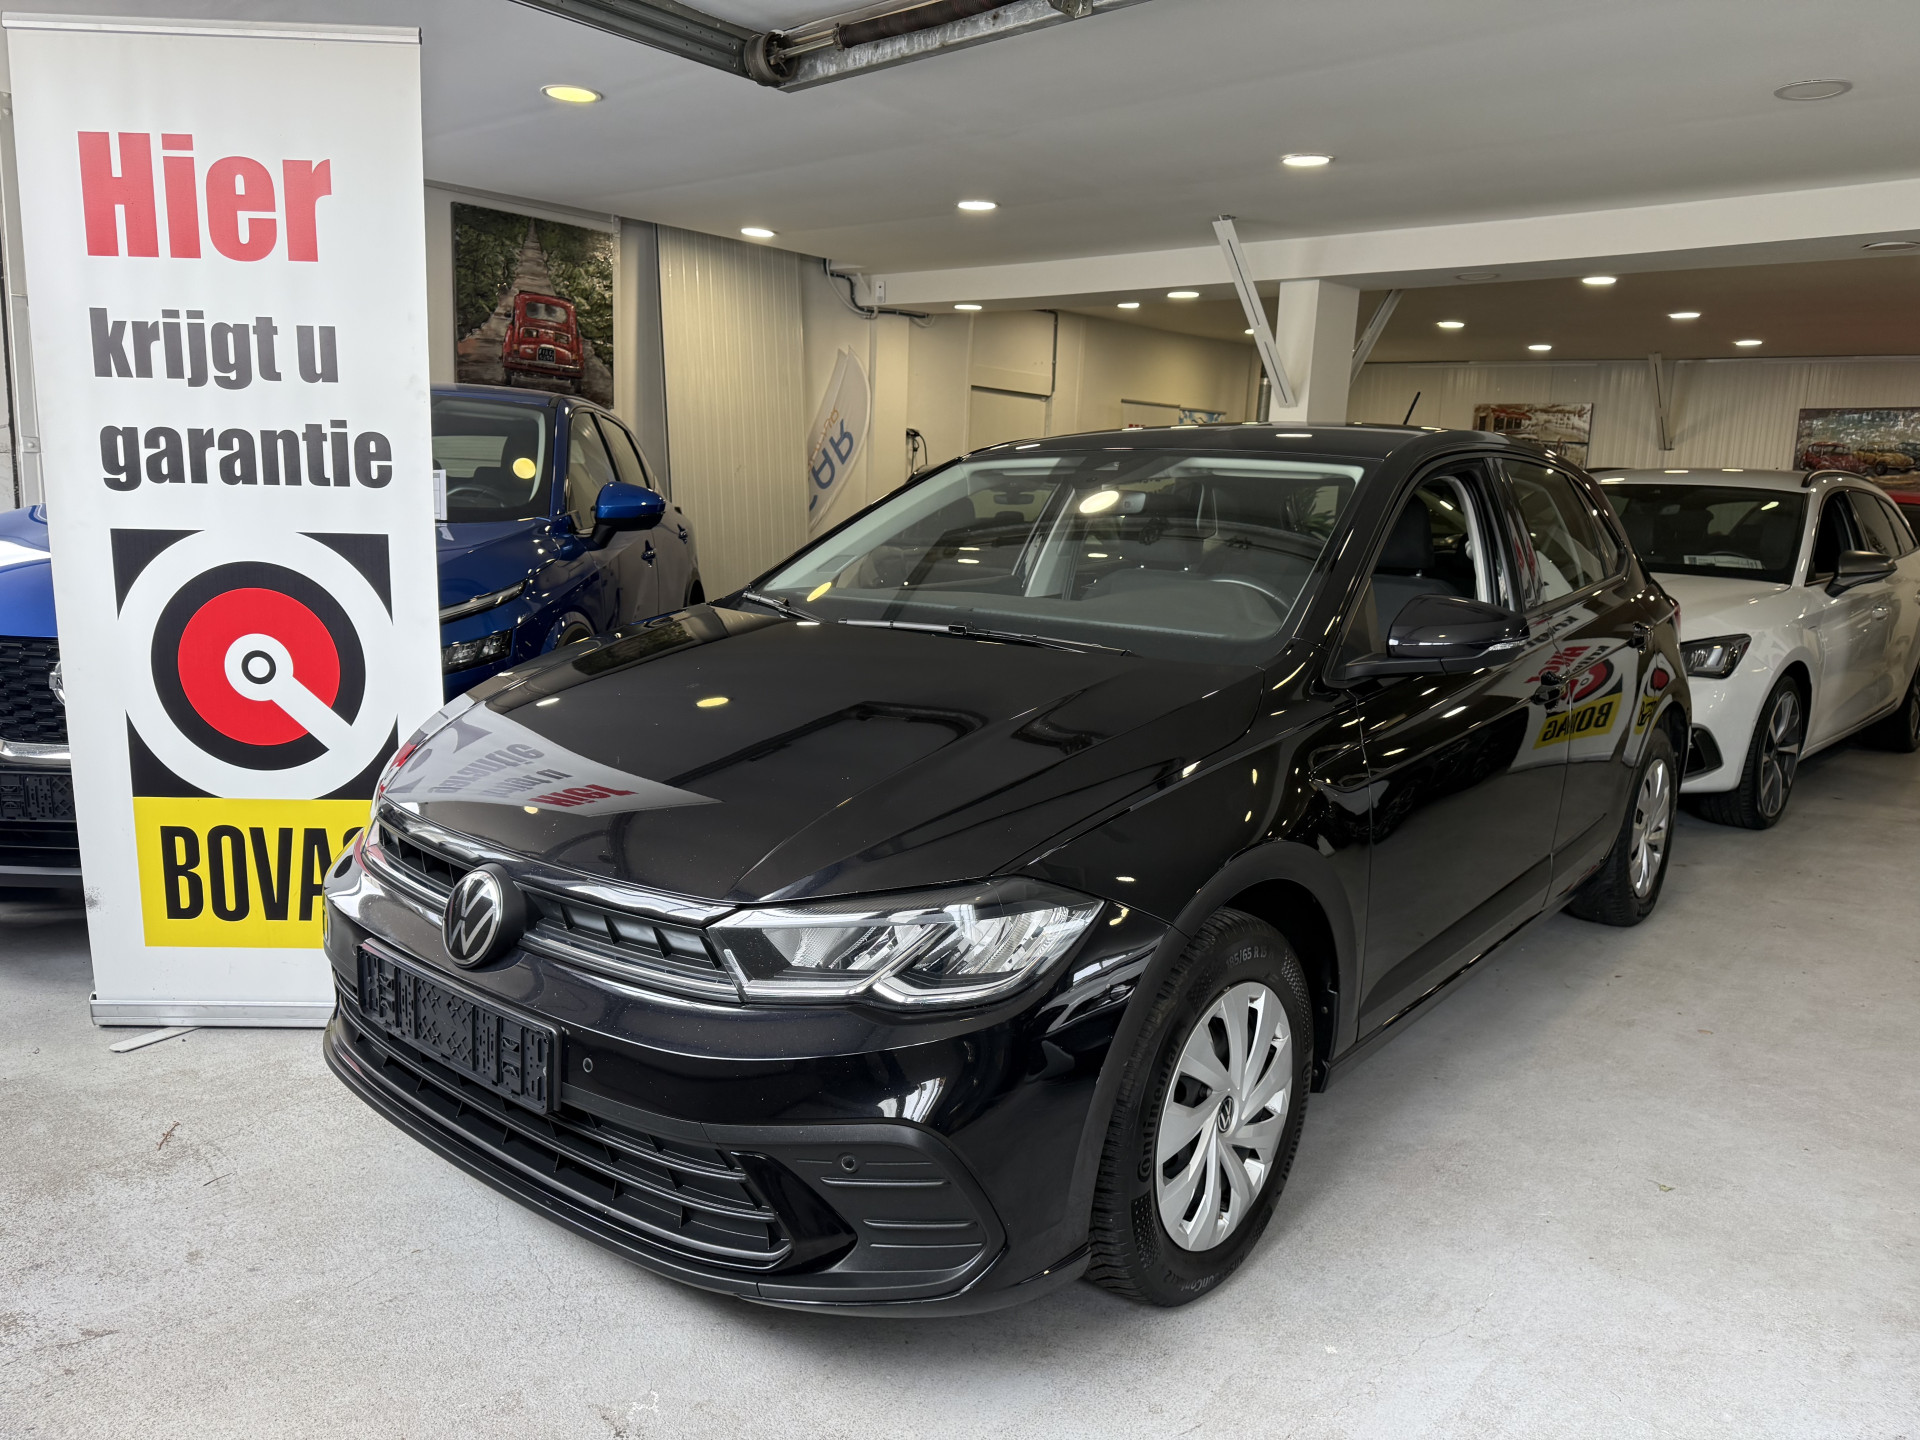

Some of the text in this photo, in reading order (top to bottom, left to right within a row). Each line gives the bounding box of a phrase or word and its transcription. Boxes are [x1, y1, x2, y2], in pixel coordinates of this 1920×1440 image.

[77, 131, 332, 262] Hier
[89, 307, 338, 390] krijgt u
[100, 419, 393, 492] garantie
[160, 825, 363, 921] BOVA
